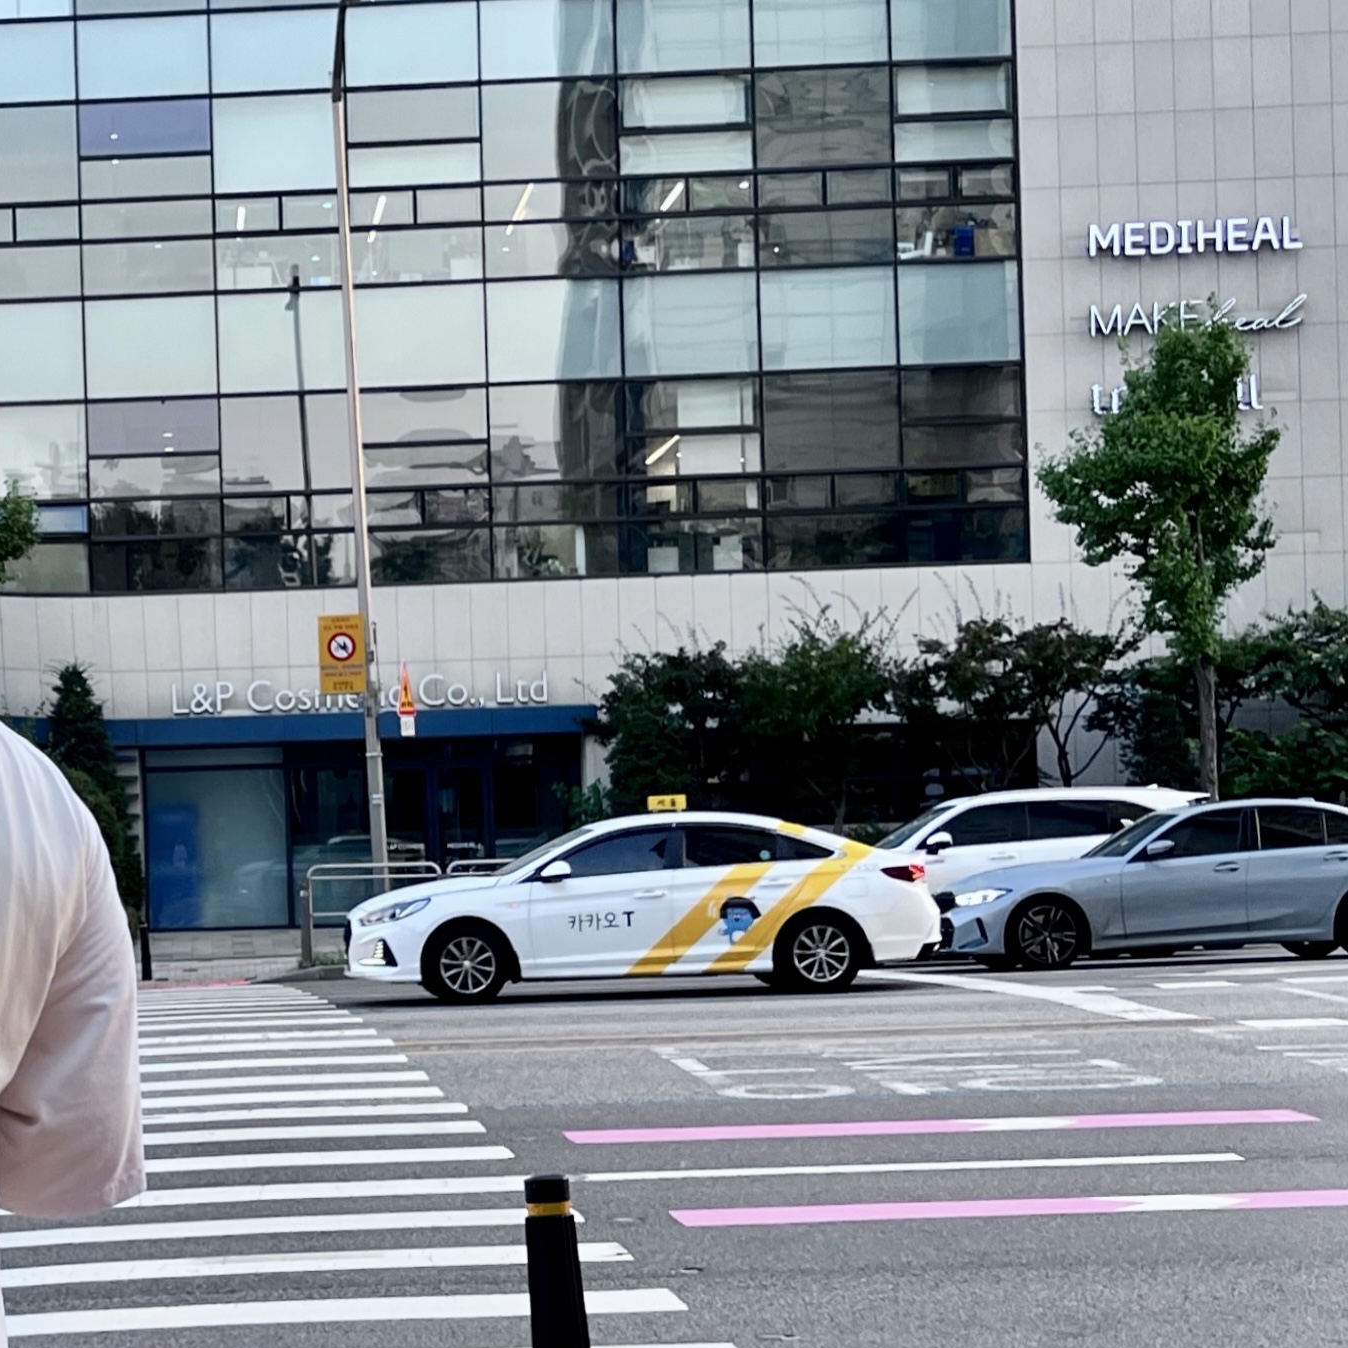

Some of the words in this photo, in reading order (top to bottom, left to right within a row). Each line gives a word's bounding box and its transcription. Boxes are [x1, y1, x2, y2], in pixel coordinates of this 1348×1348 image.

[1088, 215, 1303, 257] MEDIHEAL
[171, 681, 234, 715] L&P
[418, 673, 485, 708] Co.,
[496, 670, 548, 704] Ltd
[567, 912, 620, 932] 카카오
[621, 910, 635, 928] T
